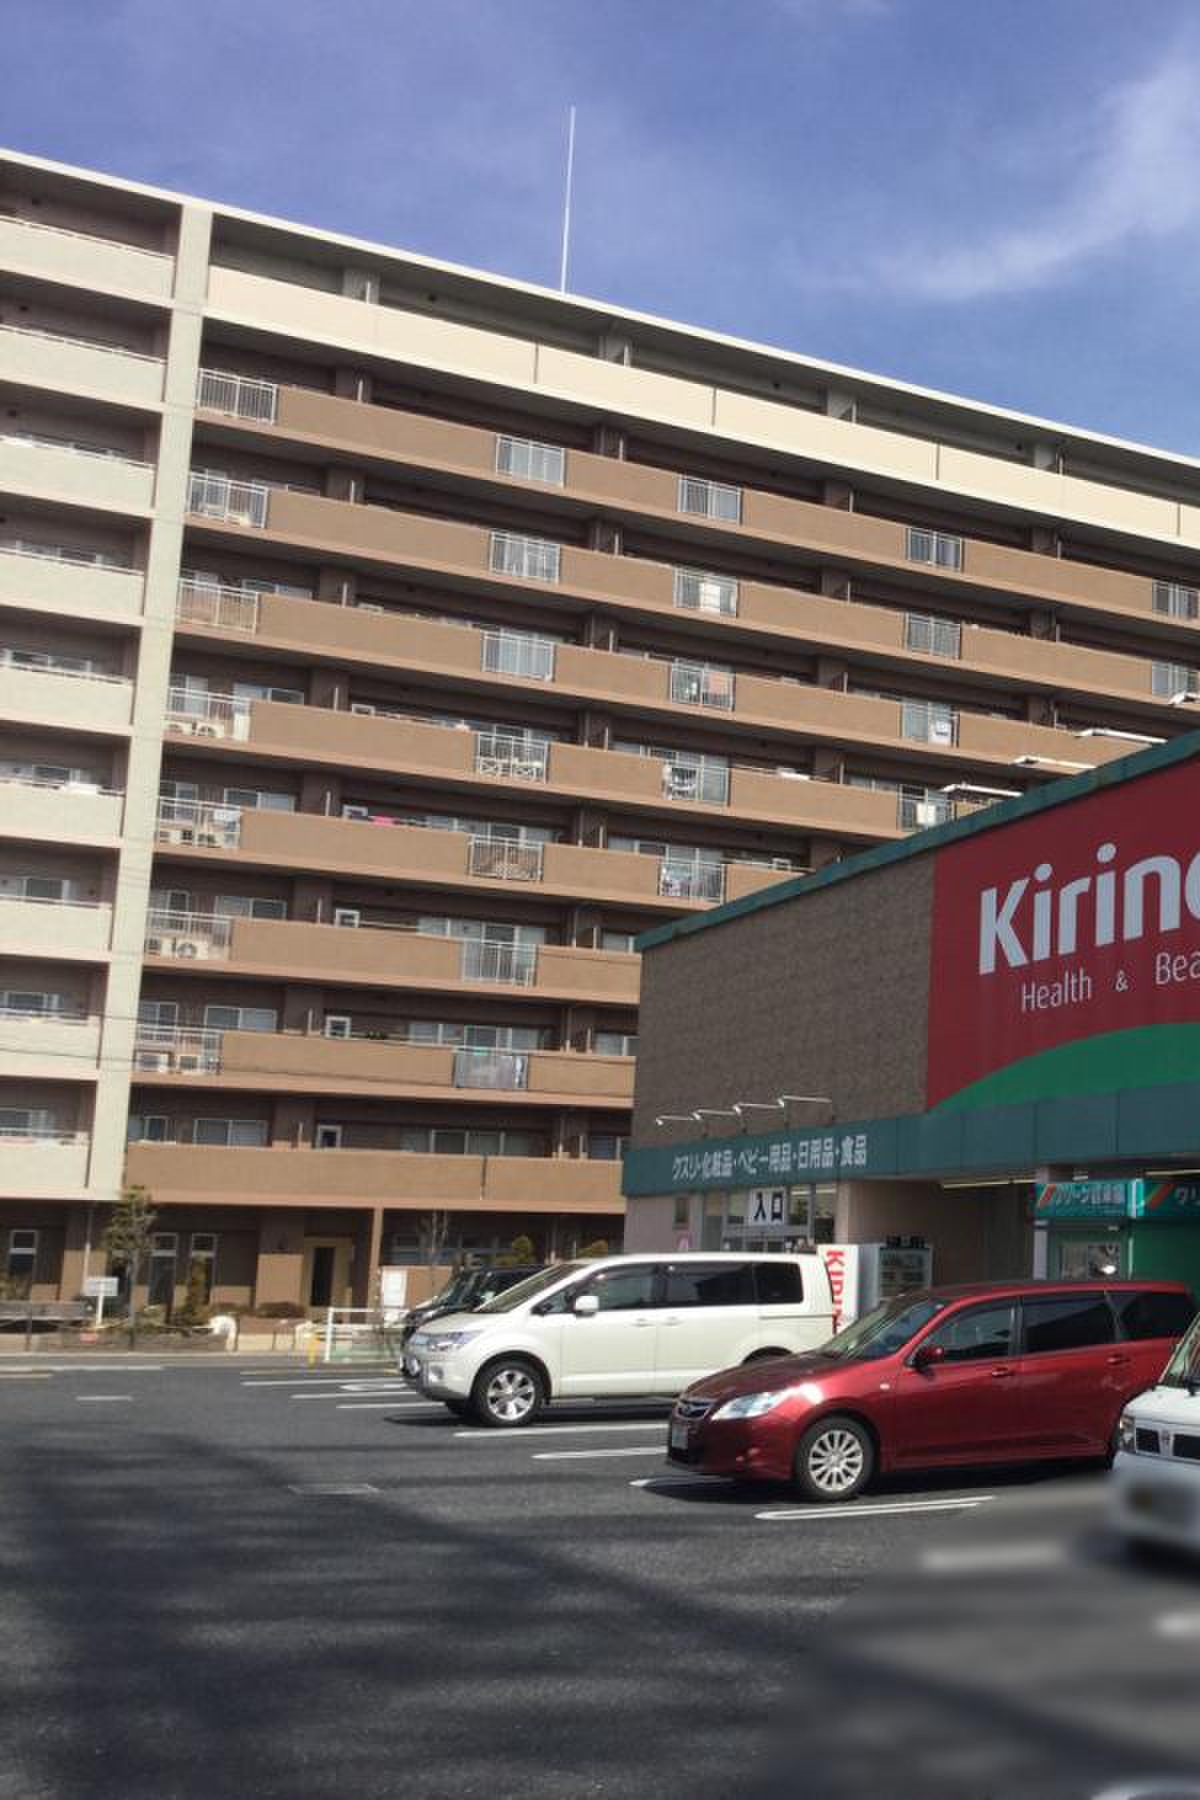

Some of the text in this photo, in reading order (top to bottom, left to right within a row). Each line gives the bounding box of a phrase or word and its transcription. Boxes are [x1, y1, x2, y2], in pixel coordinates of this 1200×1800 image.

[1021, 966, 1092, 1013] Health
[1115, 970, 1129, 993] &
[753, 1190, 785, 1222] 入口
